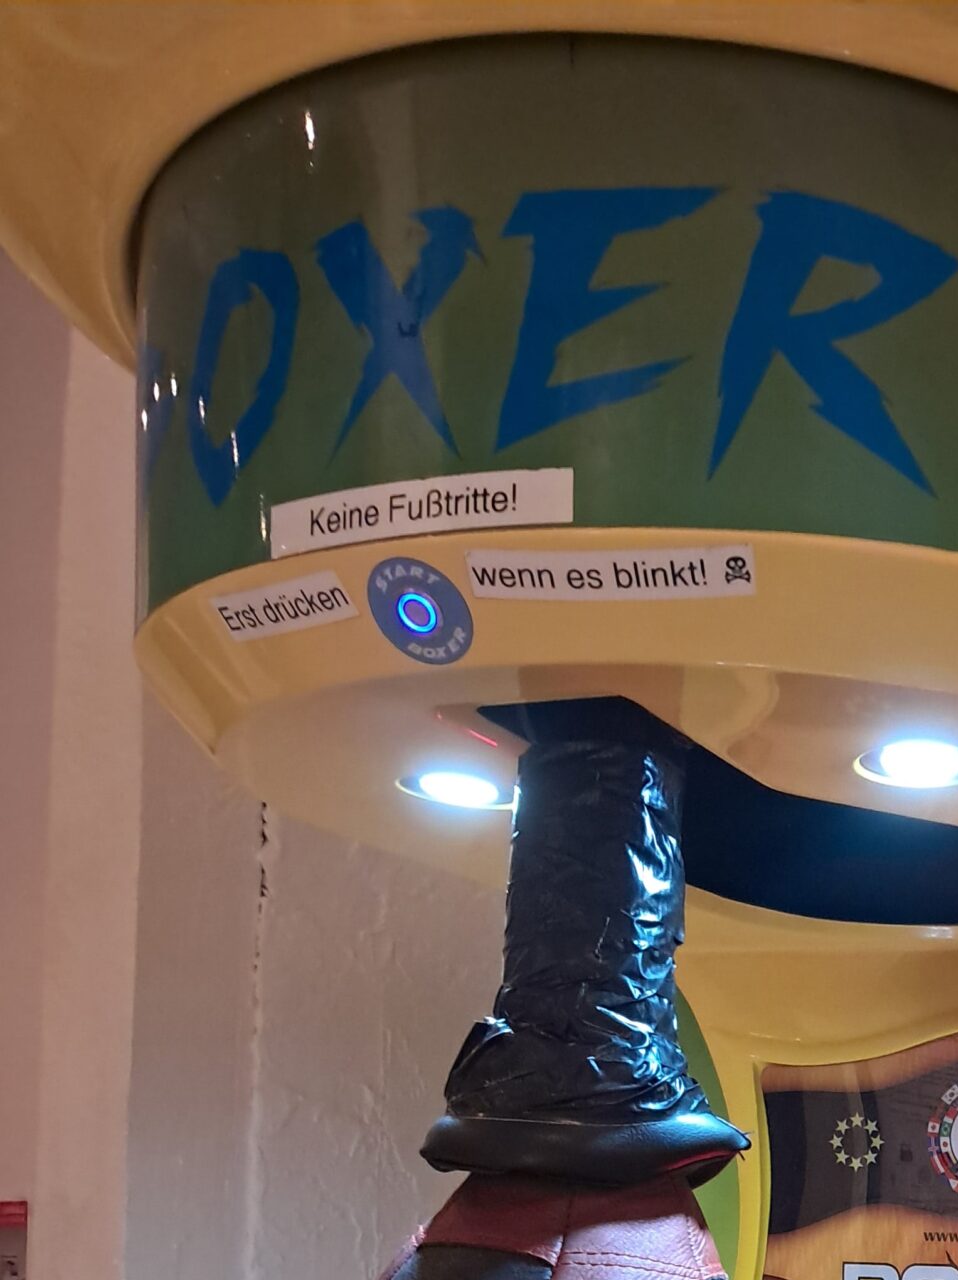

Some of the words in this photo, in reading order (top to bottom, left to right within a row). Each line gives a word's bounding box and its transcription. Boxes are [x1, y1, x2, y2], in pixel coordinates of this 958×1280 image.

[309, 505, 379, 536] Keine
[389, 483, 518, 523] Fußtritte!
[376, 564, 440, 594] START
[472, 565, 555, 589] wenn
[567, 566, 603, 589] es
[613, 559, 708, 588] blinkt!
[218, 604, 261, 631] Erst
[263, 584, 349, 625] drücken
[407, 627, 466, 657] BOXER
